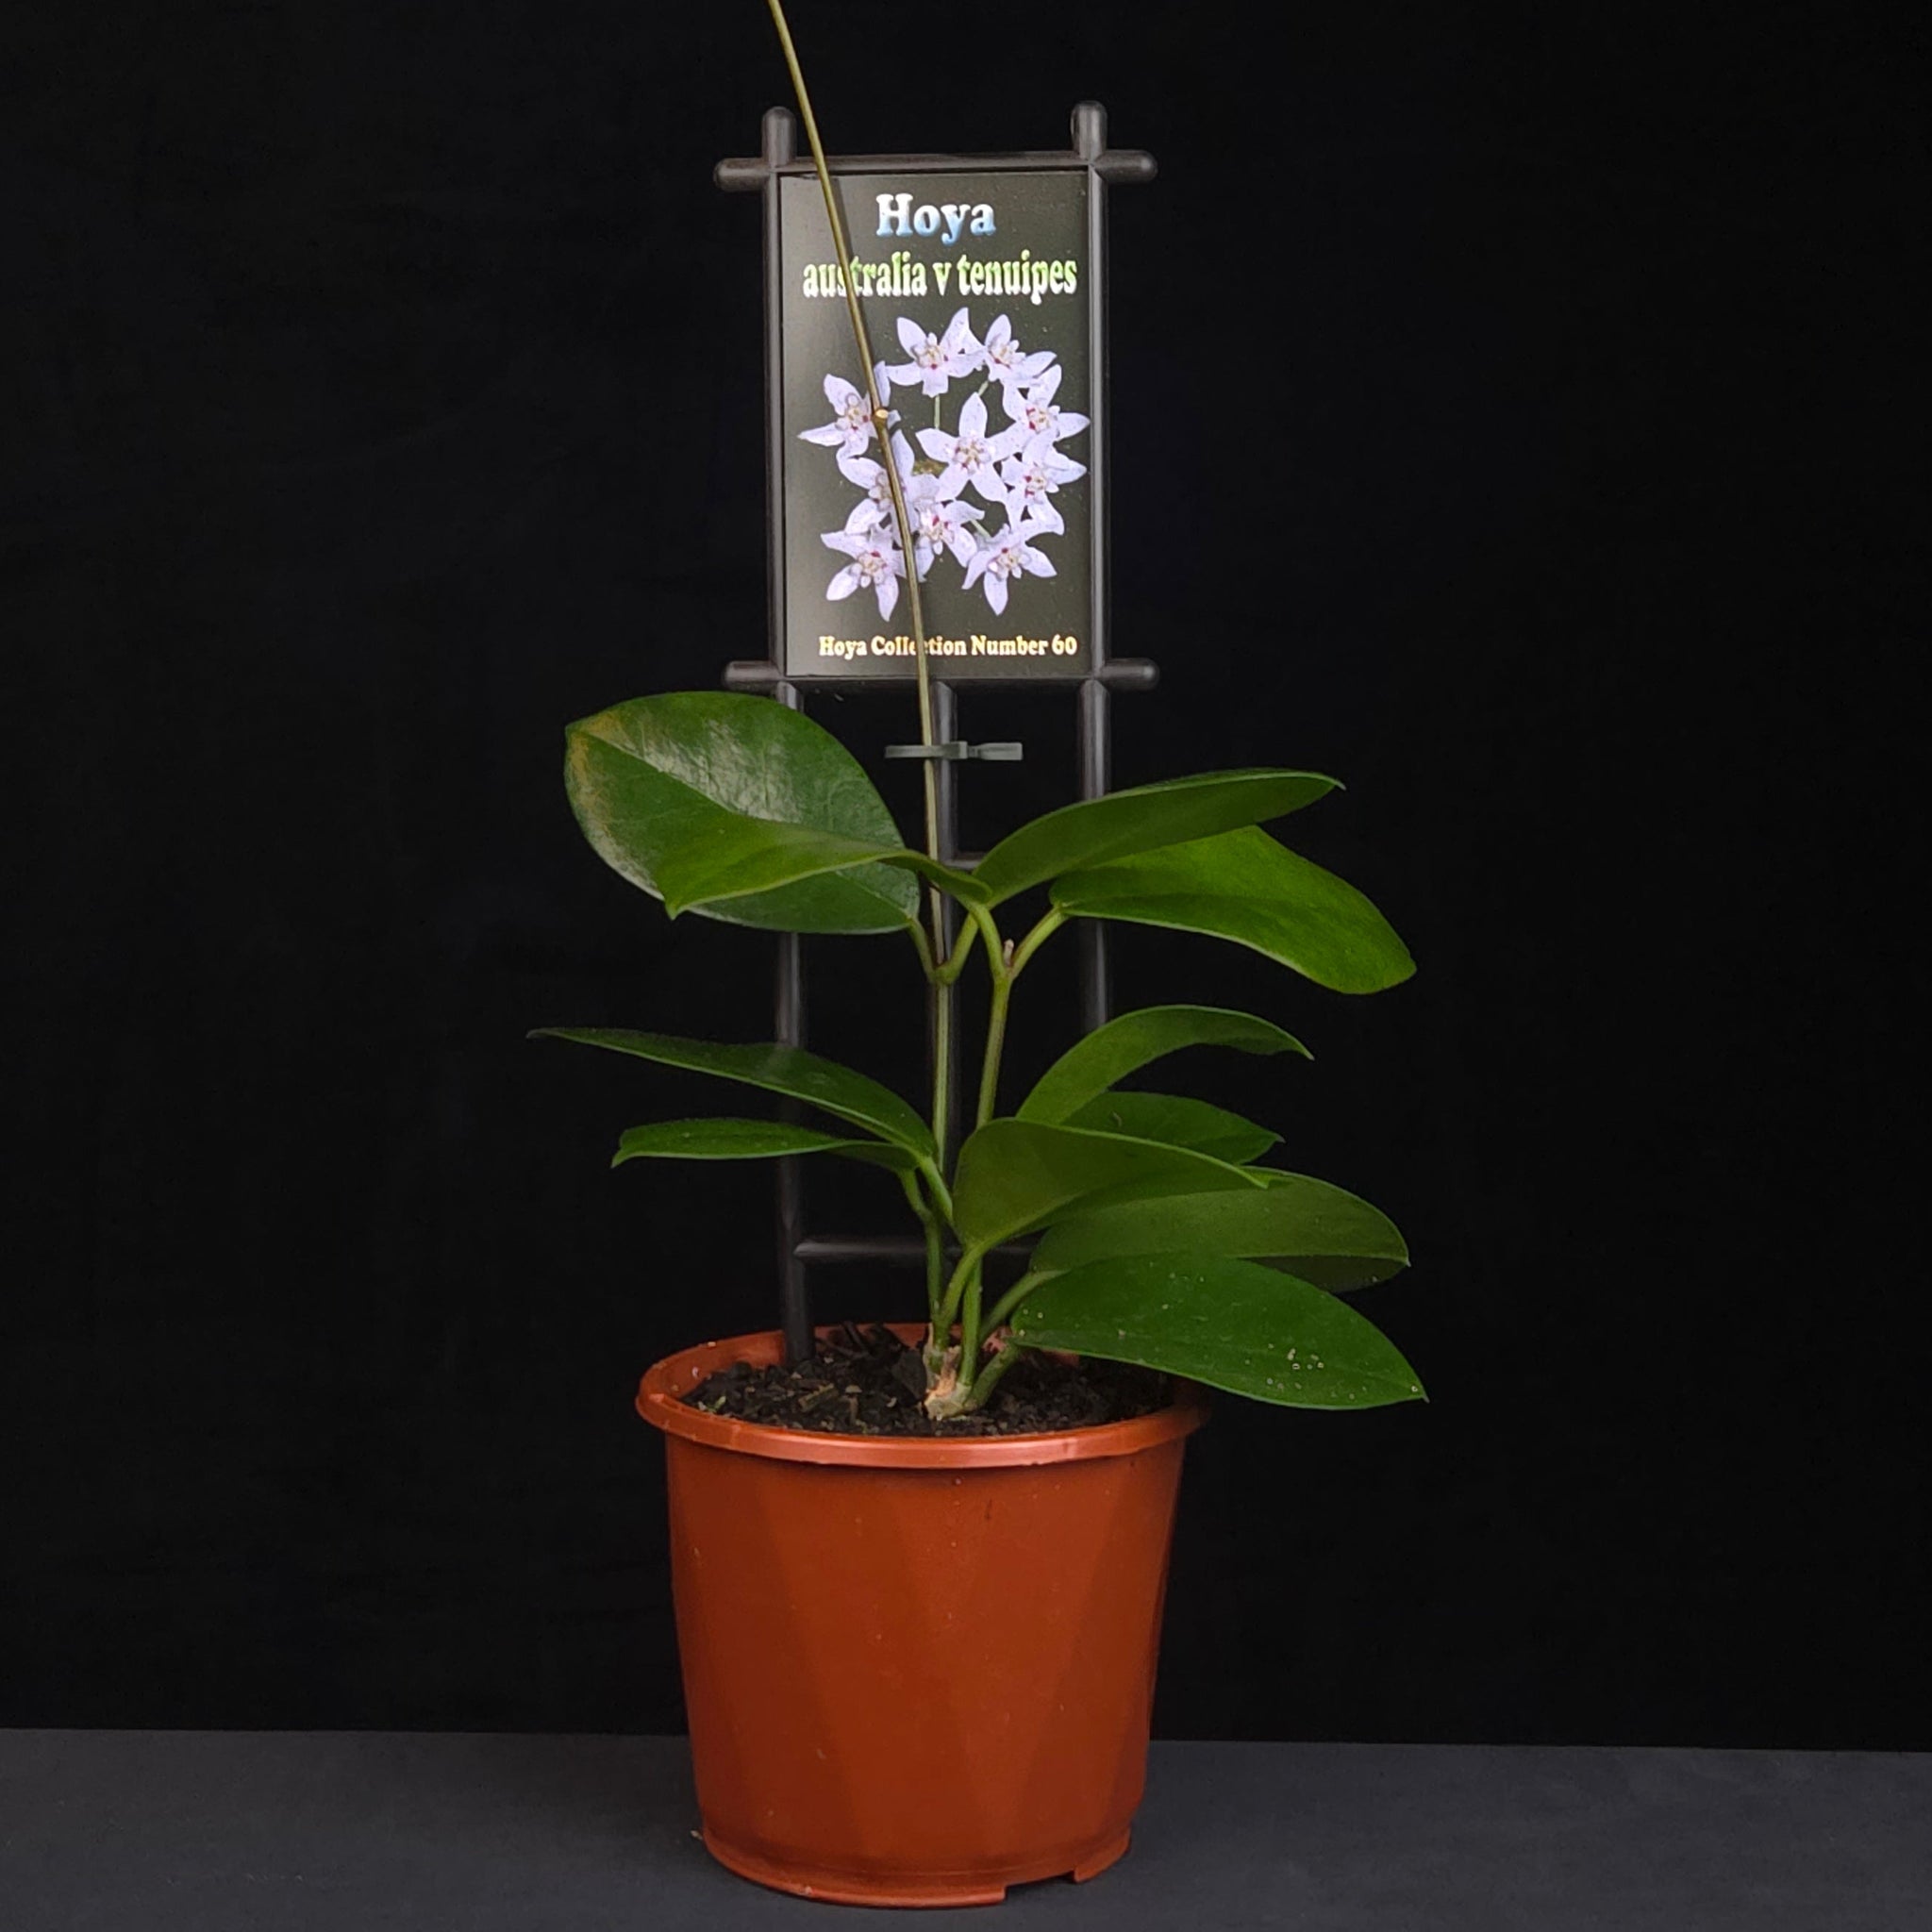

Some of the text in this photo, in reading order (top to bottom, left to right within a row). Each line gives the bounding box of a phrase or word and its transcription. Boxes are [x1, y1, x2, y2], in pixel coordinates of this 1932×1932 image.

[875, 193, 996, 245] Hoya
[803, 249, 1077, 305] australia v tenuipes
[819, 636, 867, 659] Hoya
[971, 635, 1048, 657] Number
[1051, 634, 1077, 656] 60
